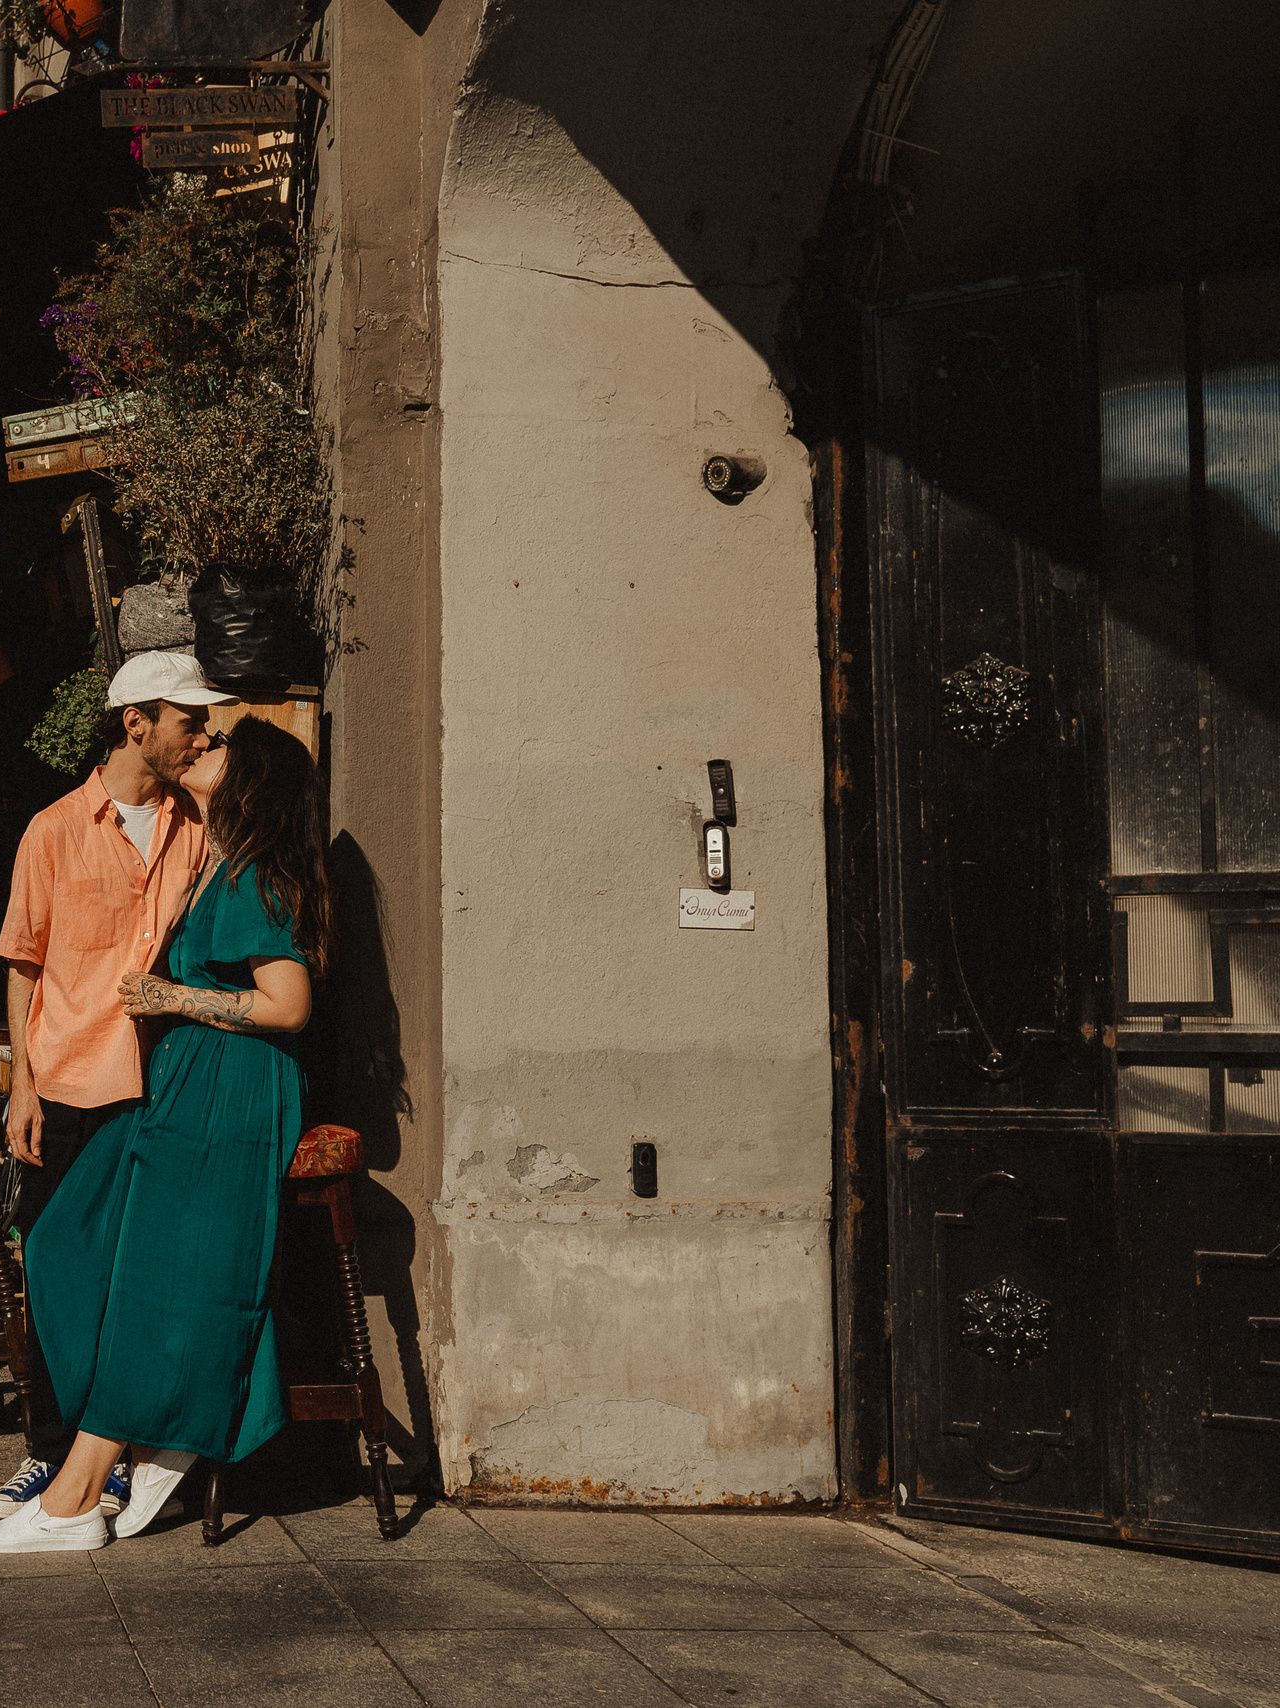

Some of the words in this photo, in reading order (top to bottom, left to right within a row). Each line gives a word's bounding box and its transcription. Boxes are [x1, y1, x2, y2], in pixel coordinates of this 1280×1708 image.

[111, 97, 151, 117] THE
[157, 95, 224, 115] BLACK
[228, 93, 287, 114] SWAN
[154, 141, 186, 158] pub
[212, 142, 251, 156] shop
[37, 454, 51, 470] 4
